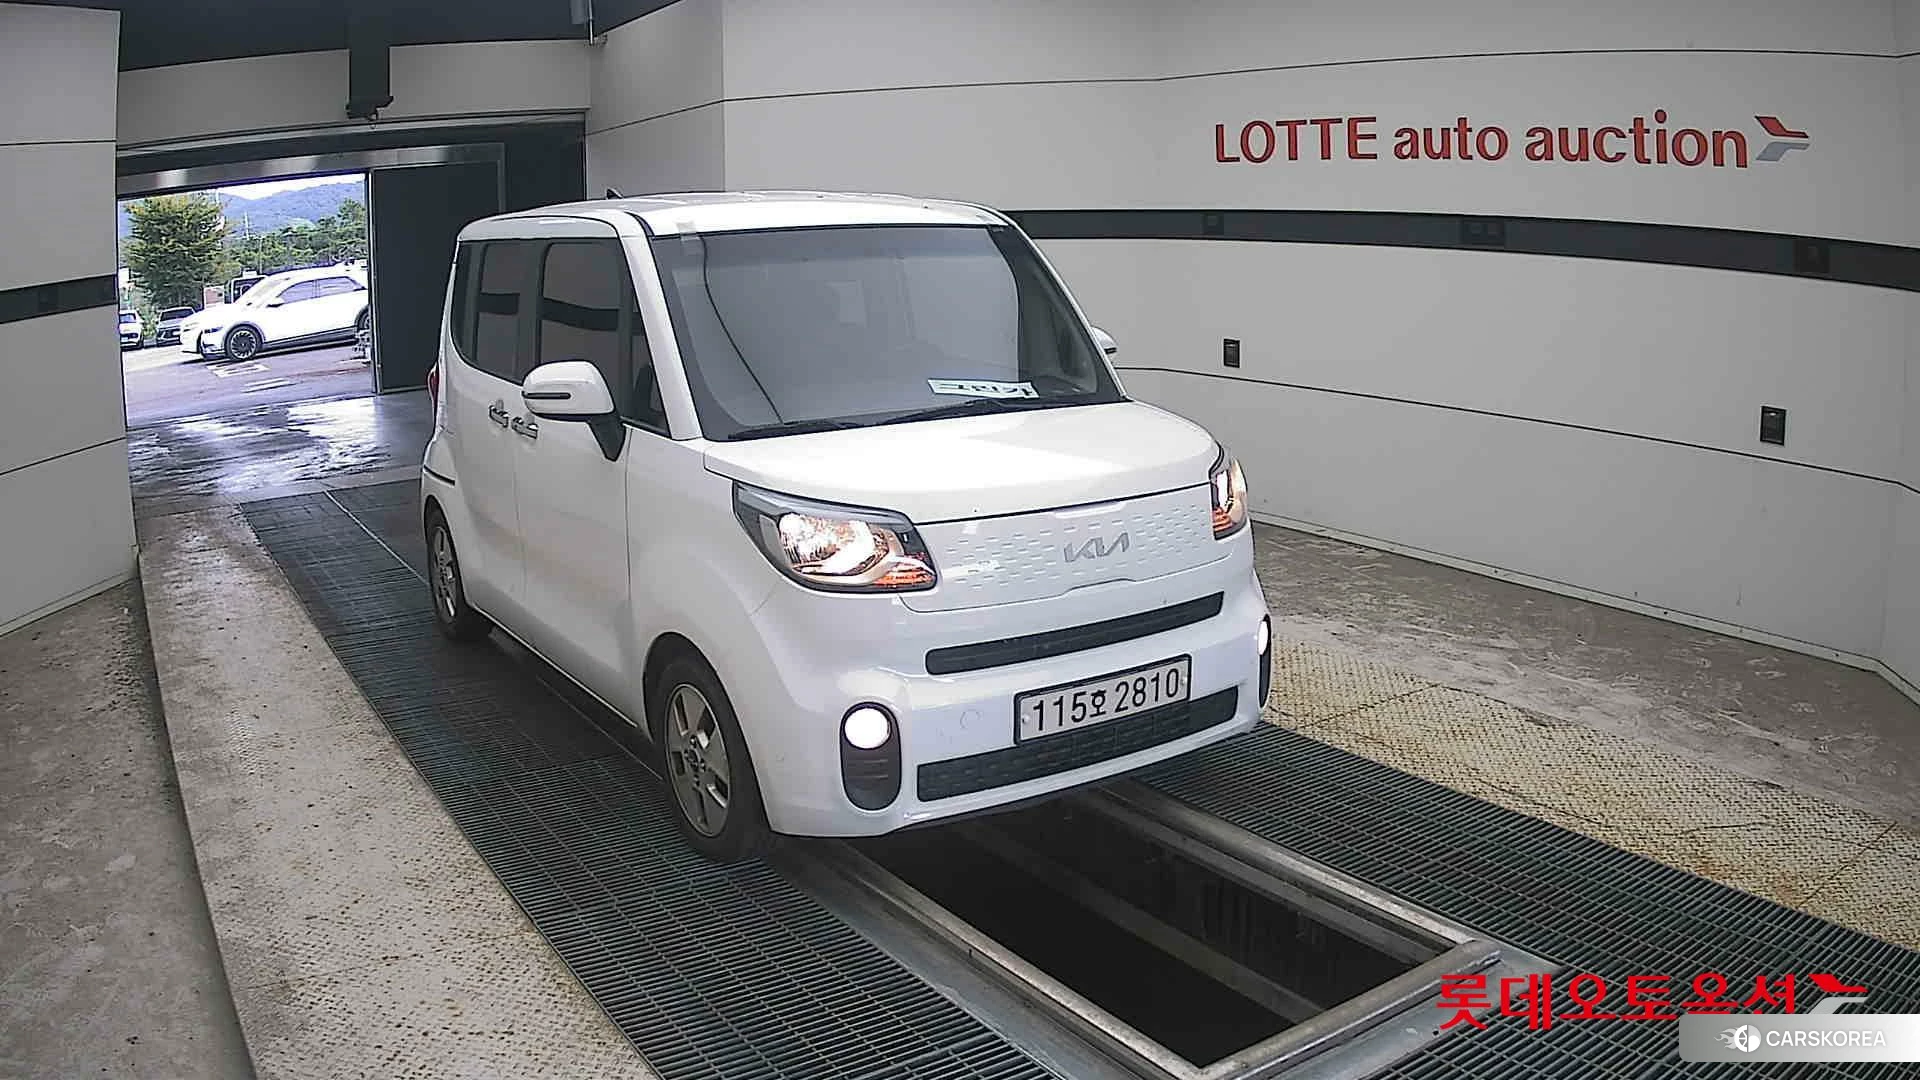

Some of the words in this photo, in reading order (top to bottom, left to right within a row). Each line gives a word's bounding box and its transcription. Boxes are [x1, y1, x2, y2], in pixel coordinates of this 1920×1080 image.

[1214, 116, 1378, 163] LOTTE
[1393, 117, 1509, 161] auto
[1525, 109, 1748, 169] auction
[1033, 689, 1107, 731] 115호
[1115, 668, 1180, 713] 2810
